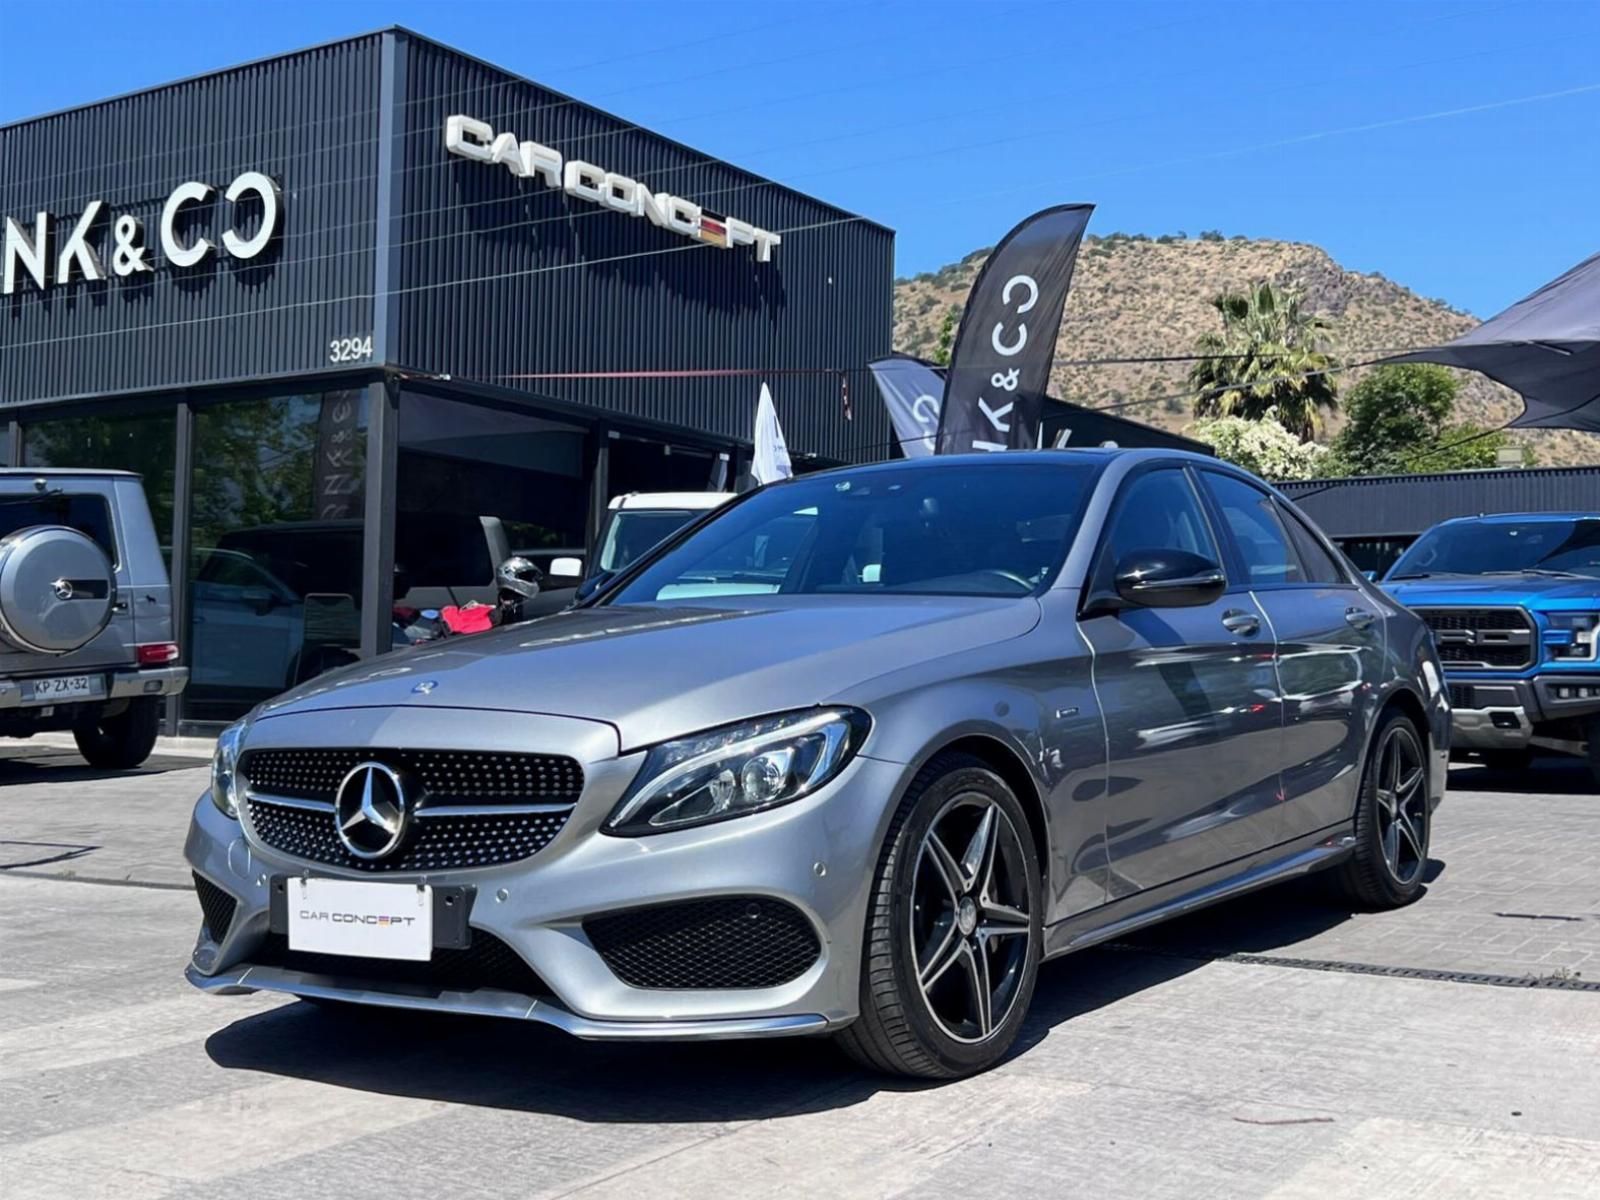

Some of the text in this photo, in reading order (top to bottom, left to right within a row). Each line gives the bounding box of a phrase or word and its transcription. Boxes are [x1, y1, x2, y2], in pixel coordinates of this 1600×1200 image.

[447, 114, 781, 262] CAR CONCEPT
[330, 335, 373, 362] 3294
[34, 680, 51, 694] KP
[299, 910, 416, 928] CAR CONCEPT
